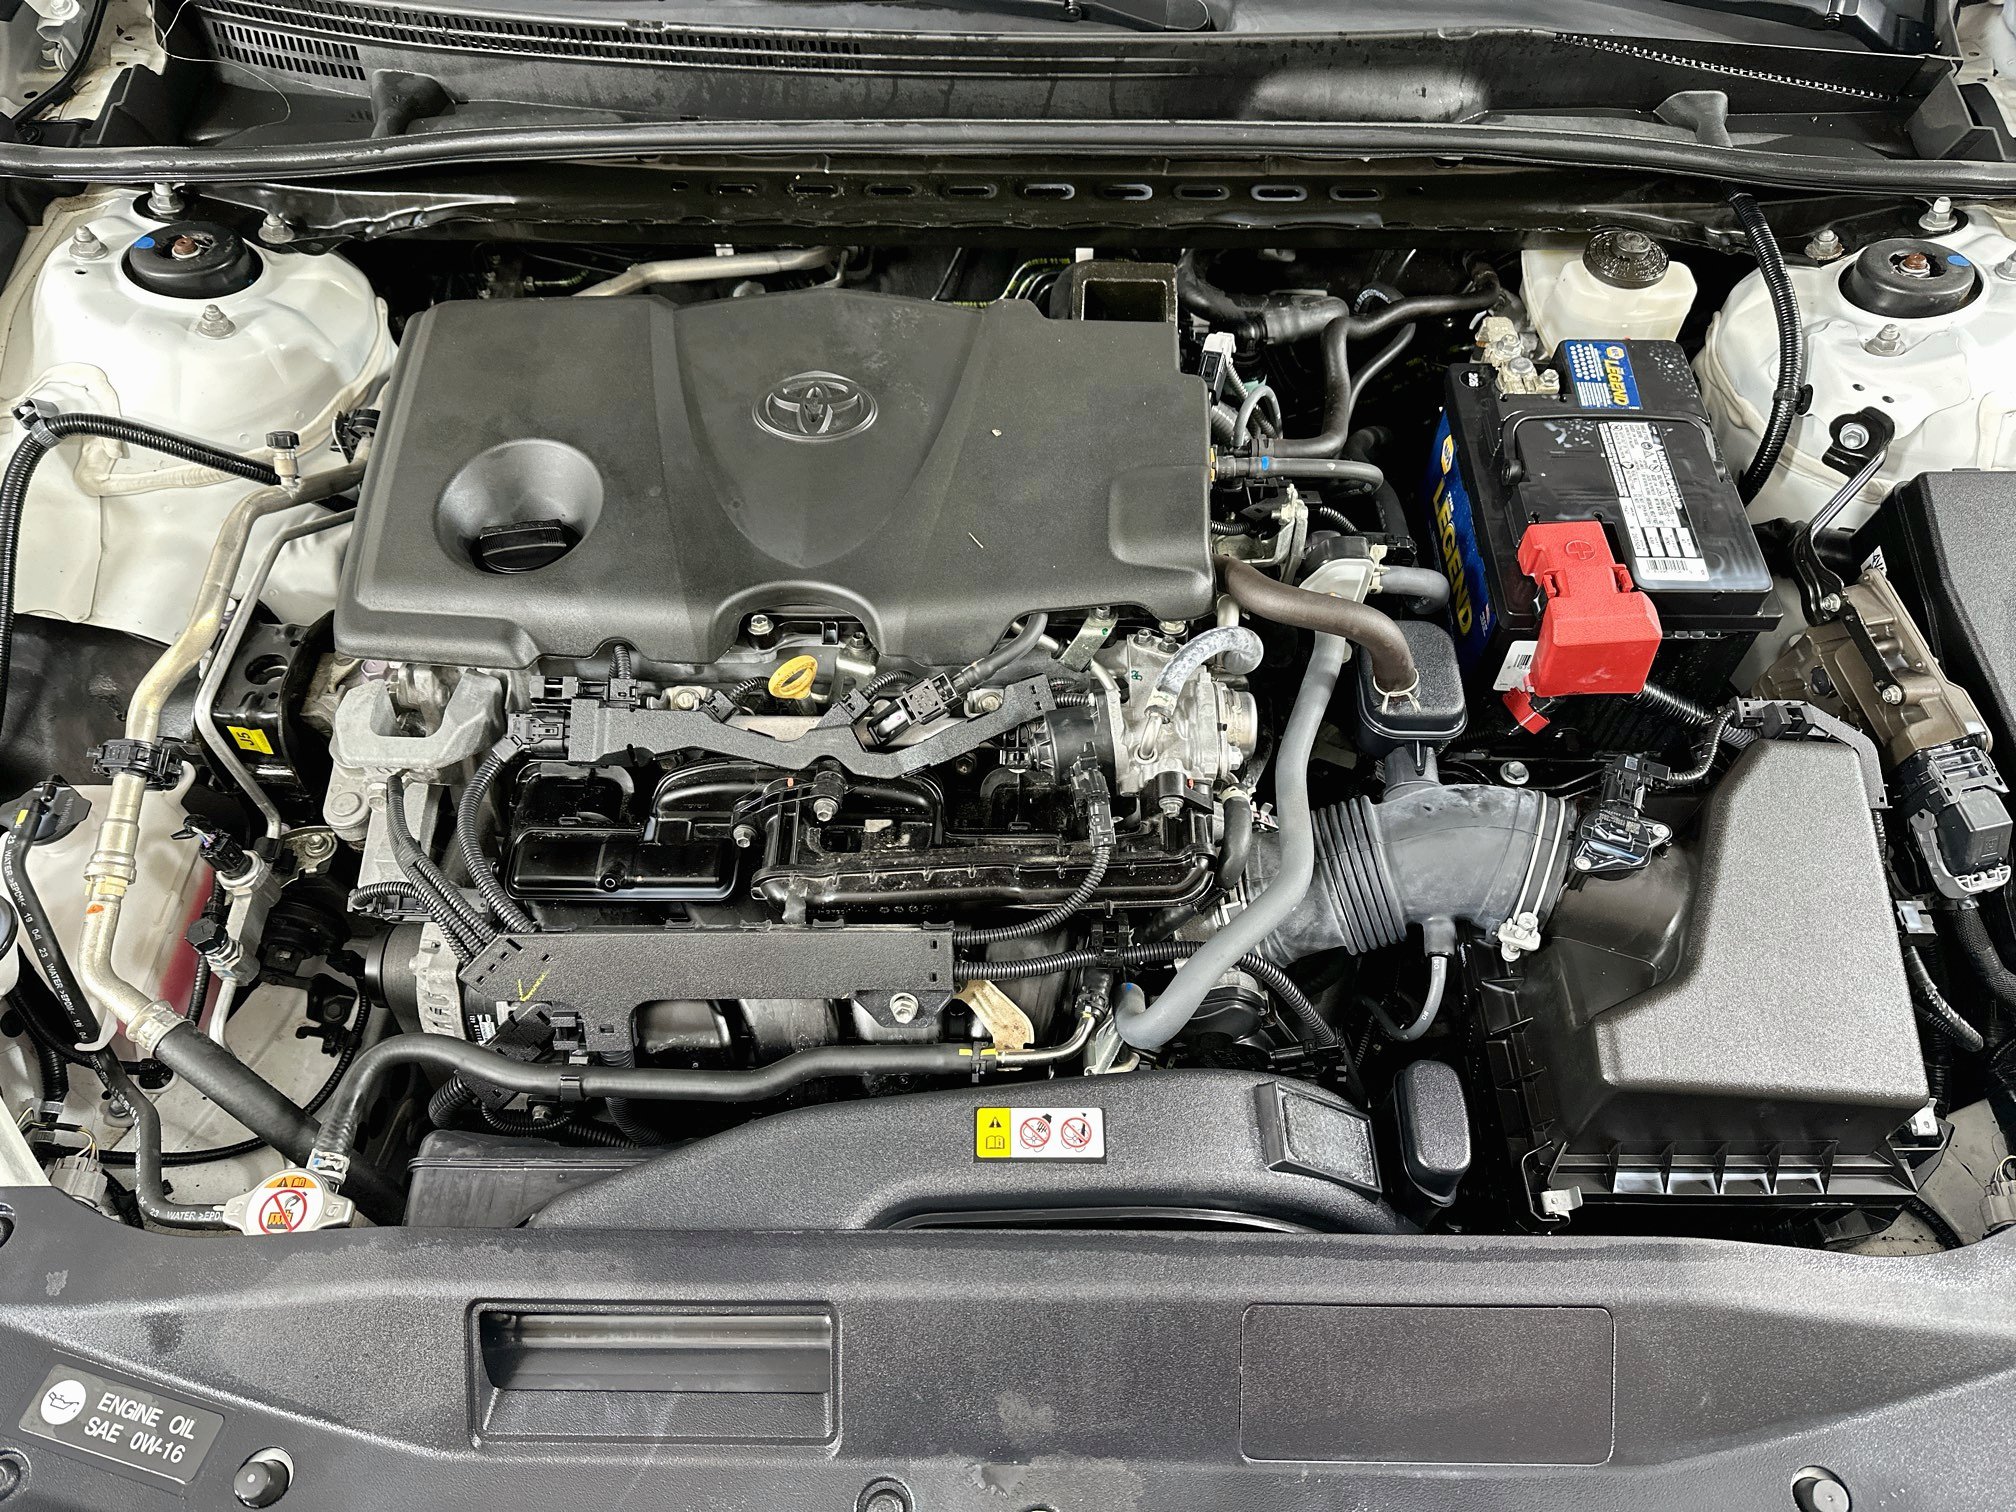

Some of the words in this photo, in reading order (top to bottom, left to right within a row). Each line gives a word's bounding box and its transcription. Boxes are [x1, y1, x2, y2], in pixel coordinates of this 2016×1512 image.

[1604, 359, 1630, 406] LEGEND
[1446, 490, 1455, 512] THE
[1433, 477, 1473, 636] LEGEND
[236, 731, 255, 746] J5
[7, 834, 17, 845] 23
[3, 849, 13, 877] WATER
[38, 947, 49, 958] 23
[46, 962, 64, 989] WATER
[149, 1207, 160, 1218] 23
[166, 1210, 197, 1221] WATER
[97, 1392, 163, 1428] ENGINE
[168, 1415, 198, 1440] OIL
[84, 1416, 124, 1444] SAE
[129, 1431, 186, 1465] 0W-16
